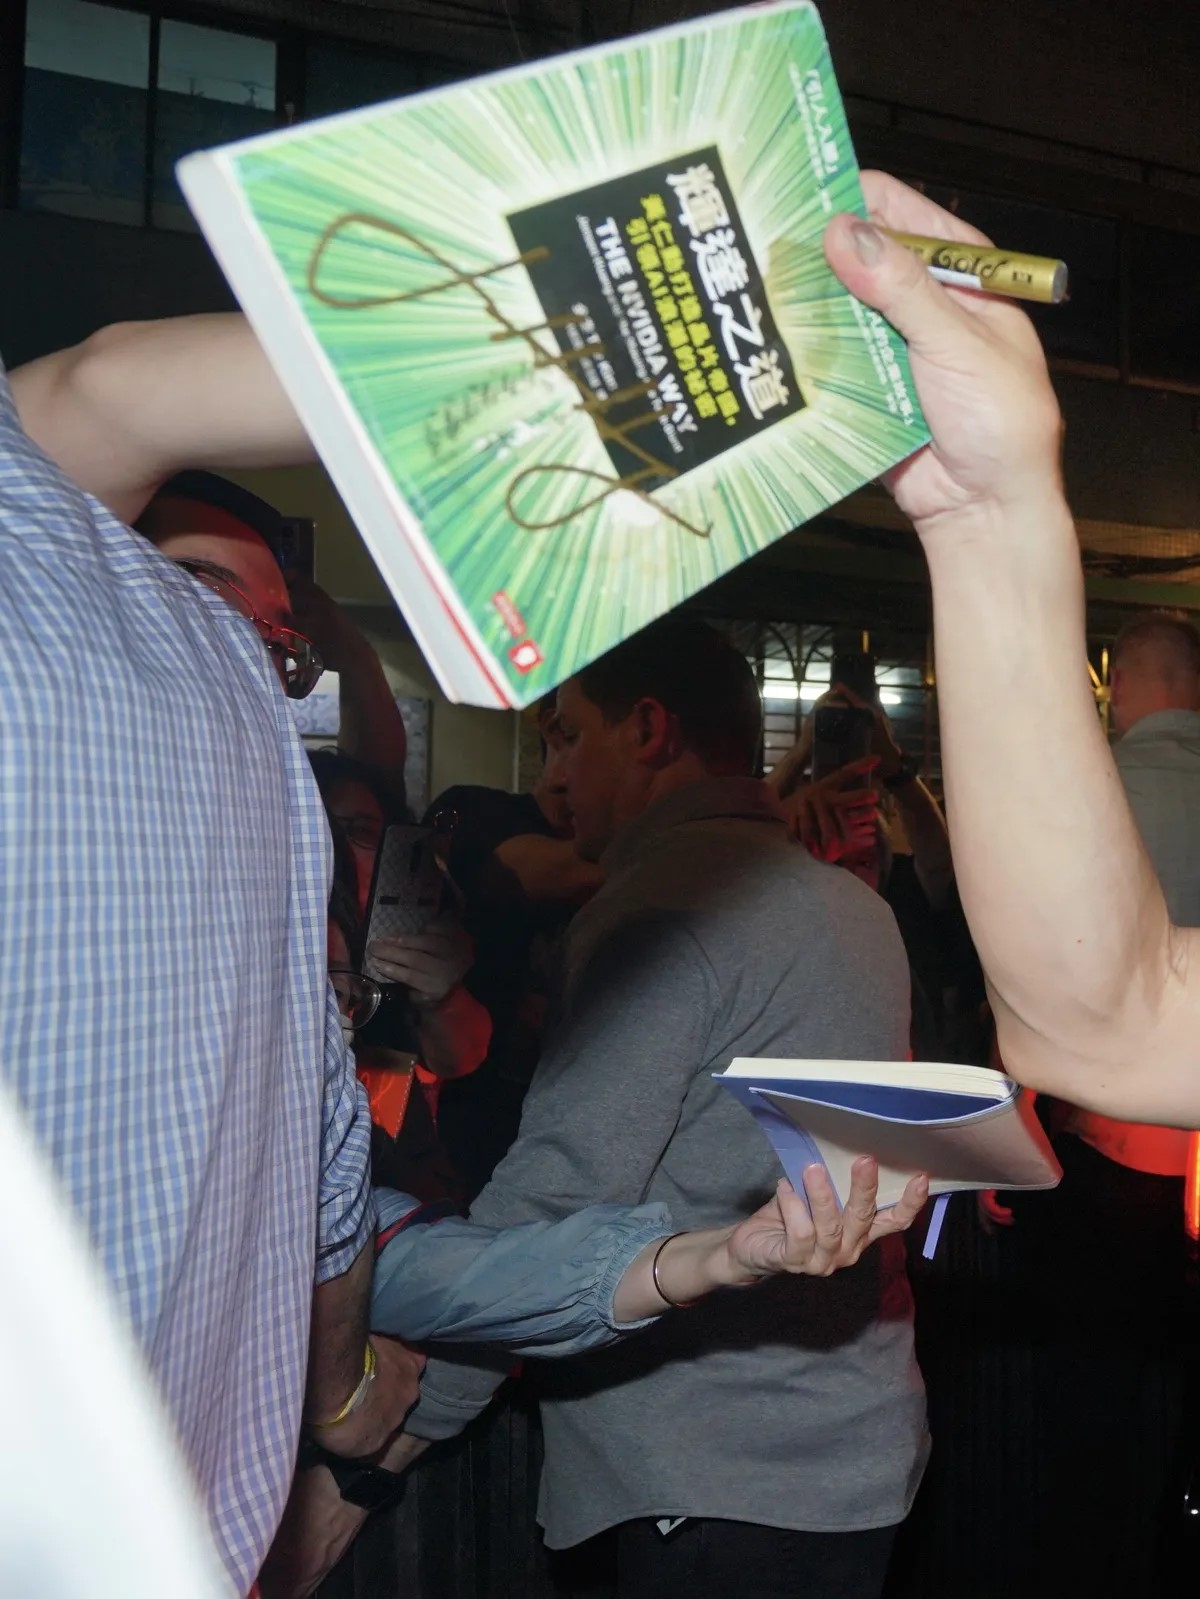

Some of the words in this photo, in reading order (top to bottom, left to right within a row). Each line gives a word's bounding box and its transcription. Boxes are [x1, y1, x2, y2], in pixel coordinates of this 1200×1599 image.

[594, 216, 633, 279] THE
[616, 279, 668, 375] NVIDIA
[656, 372, 698, 432] WAY
[666, 163, 789, 419] 輝達之道
[931, 246, 1007, 281] Gold
